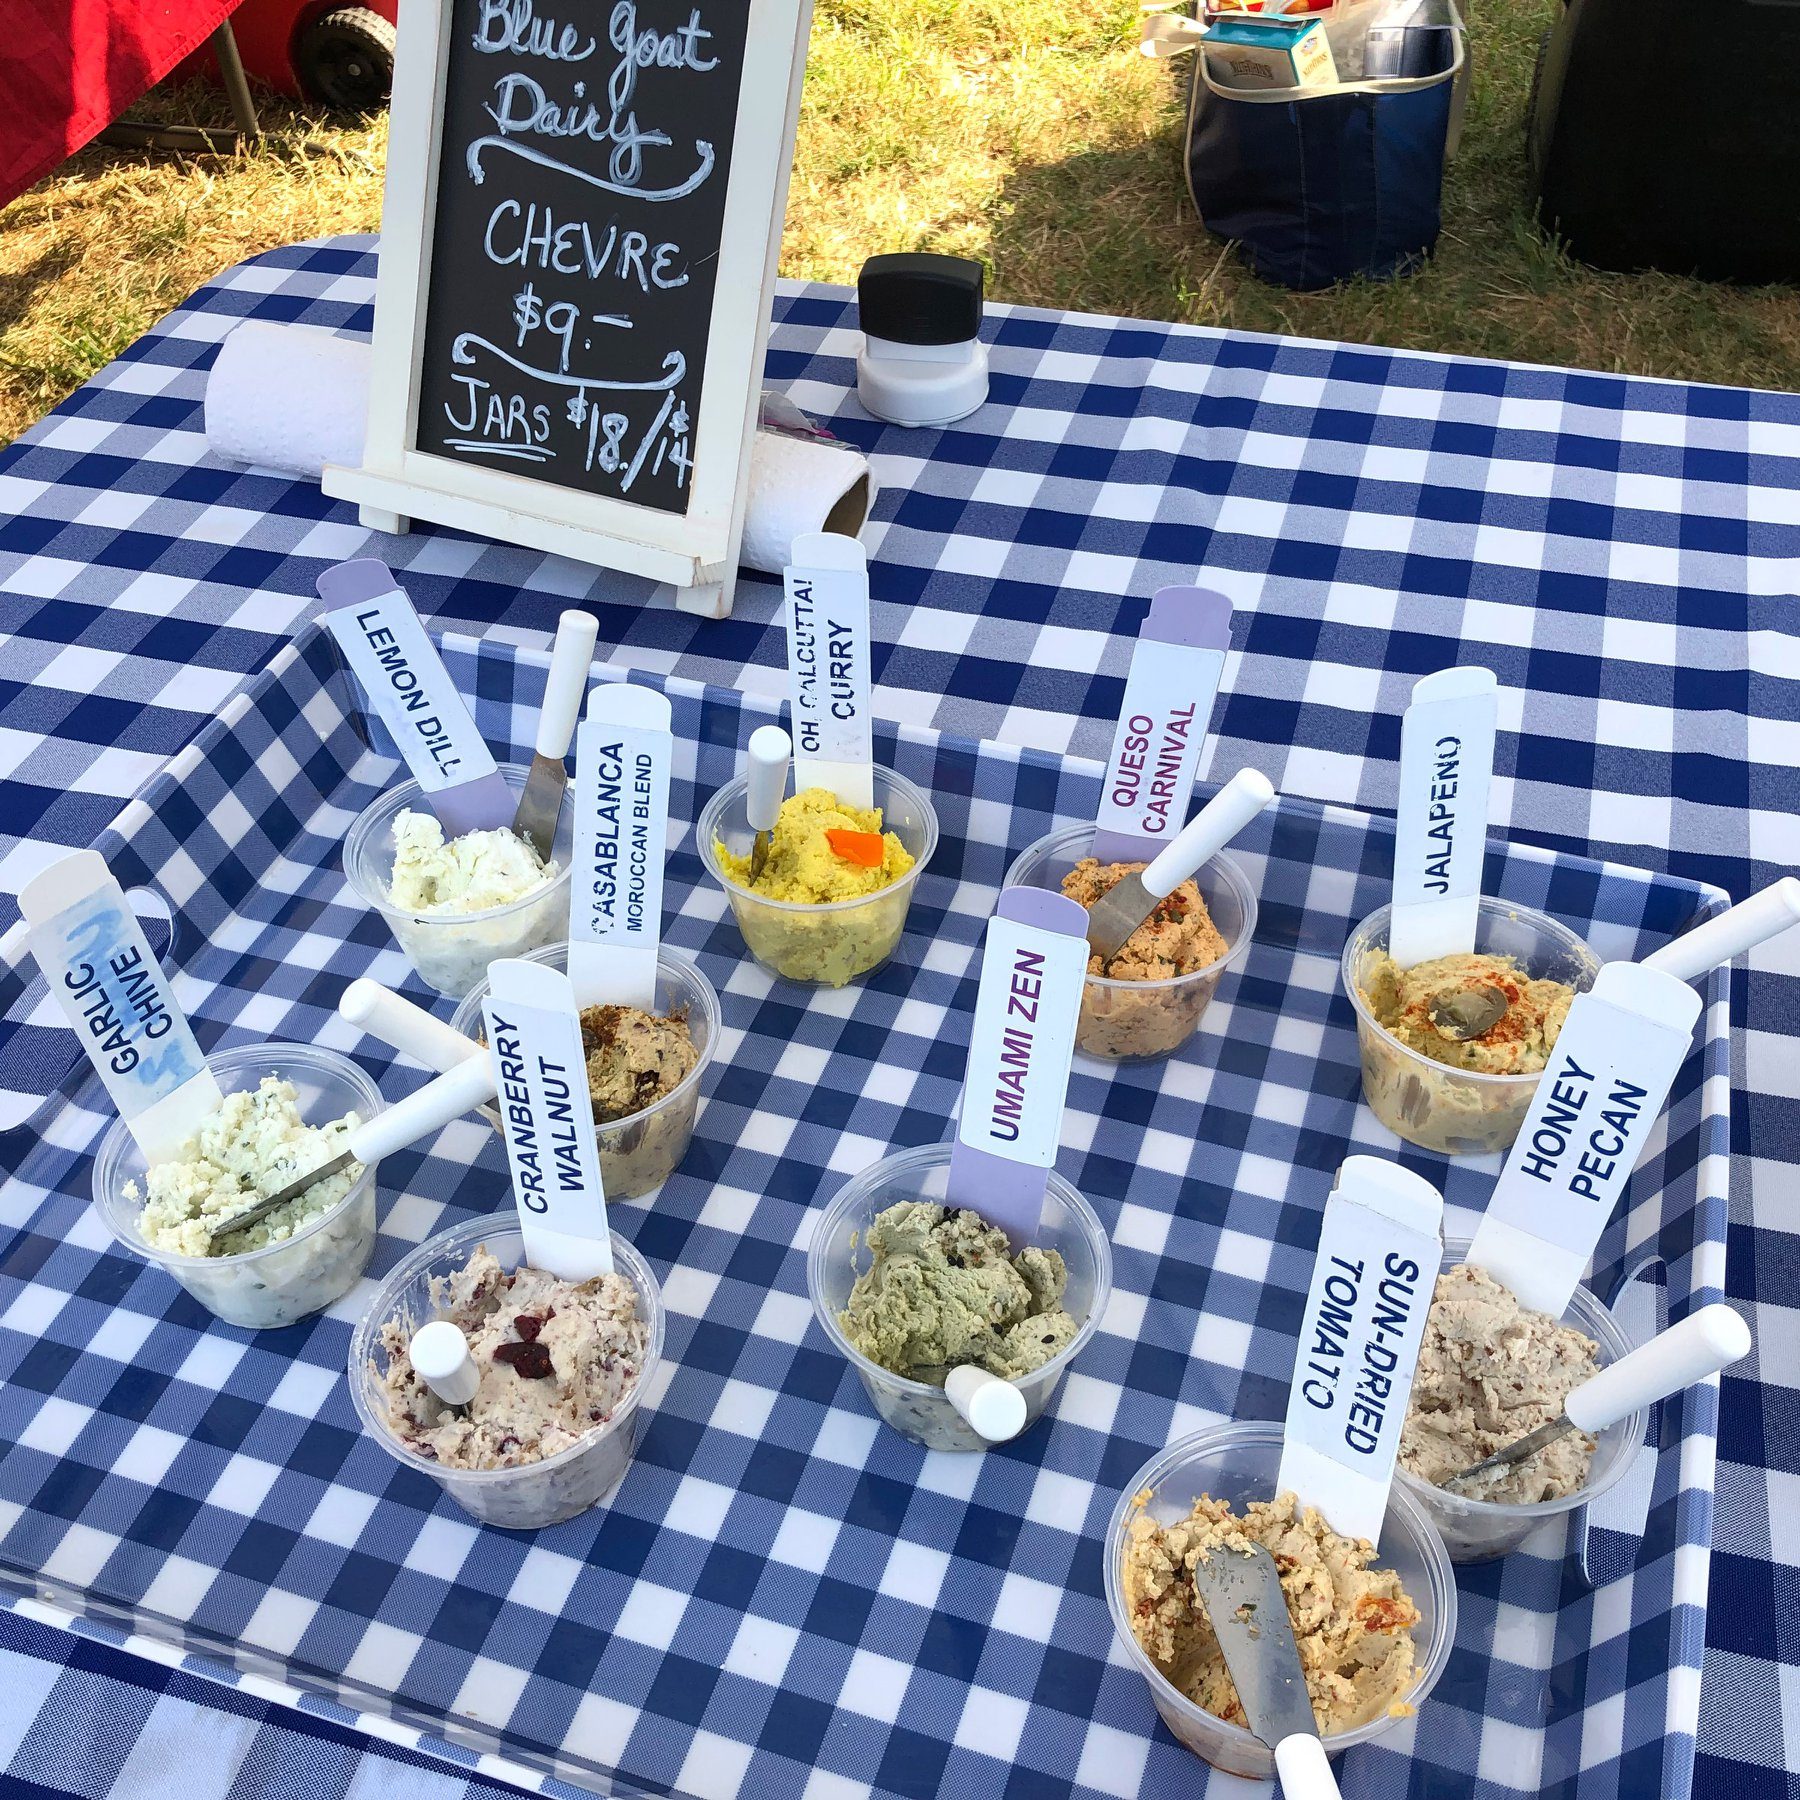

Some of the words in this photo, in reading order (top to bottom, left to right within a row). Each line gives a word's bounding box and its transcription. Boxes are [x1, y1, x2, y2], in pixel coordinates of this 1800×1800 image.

[471, 0, 596, 62] Blue
[481, 71, 672, 185] Dairy
[484, 199, 689, 292] CHEVRE
[445, 373, 551, 444] JARS
[357, 610, 429, 711] LEMON
[415, 717, 461, 777] DILL
[794, 579, 817, 708] CALCUTTA!
[828, 619, 855, 720] CURRY
[633, 754, 651, 818] BLEND
[1112, 716, 1153, 807] QUESO
[1142, 703, 1195, 832] CARNIVAL
[1424, 737, 1461, 894] JALAPENO
[627, 825, 647, 931] MOROCCAN
[65, 964, 139, 1074] GARLIC
[110, 946, 172, 1038] CHIVE
[1008, 949, 1045, 1022] ZEN
[492, 1013, 548, 1213] CRANBERRY
[538, 1056, 584, 1190] WALNUT
[990, 1028, 1033, 1141] UMAMI
[1521, 1055, 1595, 1182] HONEY
[1569, 1079, 1647, 1202] PECAN
[1303, 1256, 1364, 1409] TOMATO
[1345, 1253, 1419, 1454] SUN-DRIED
